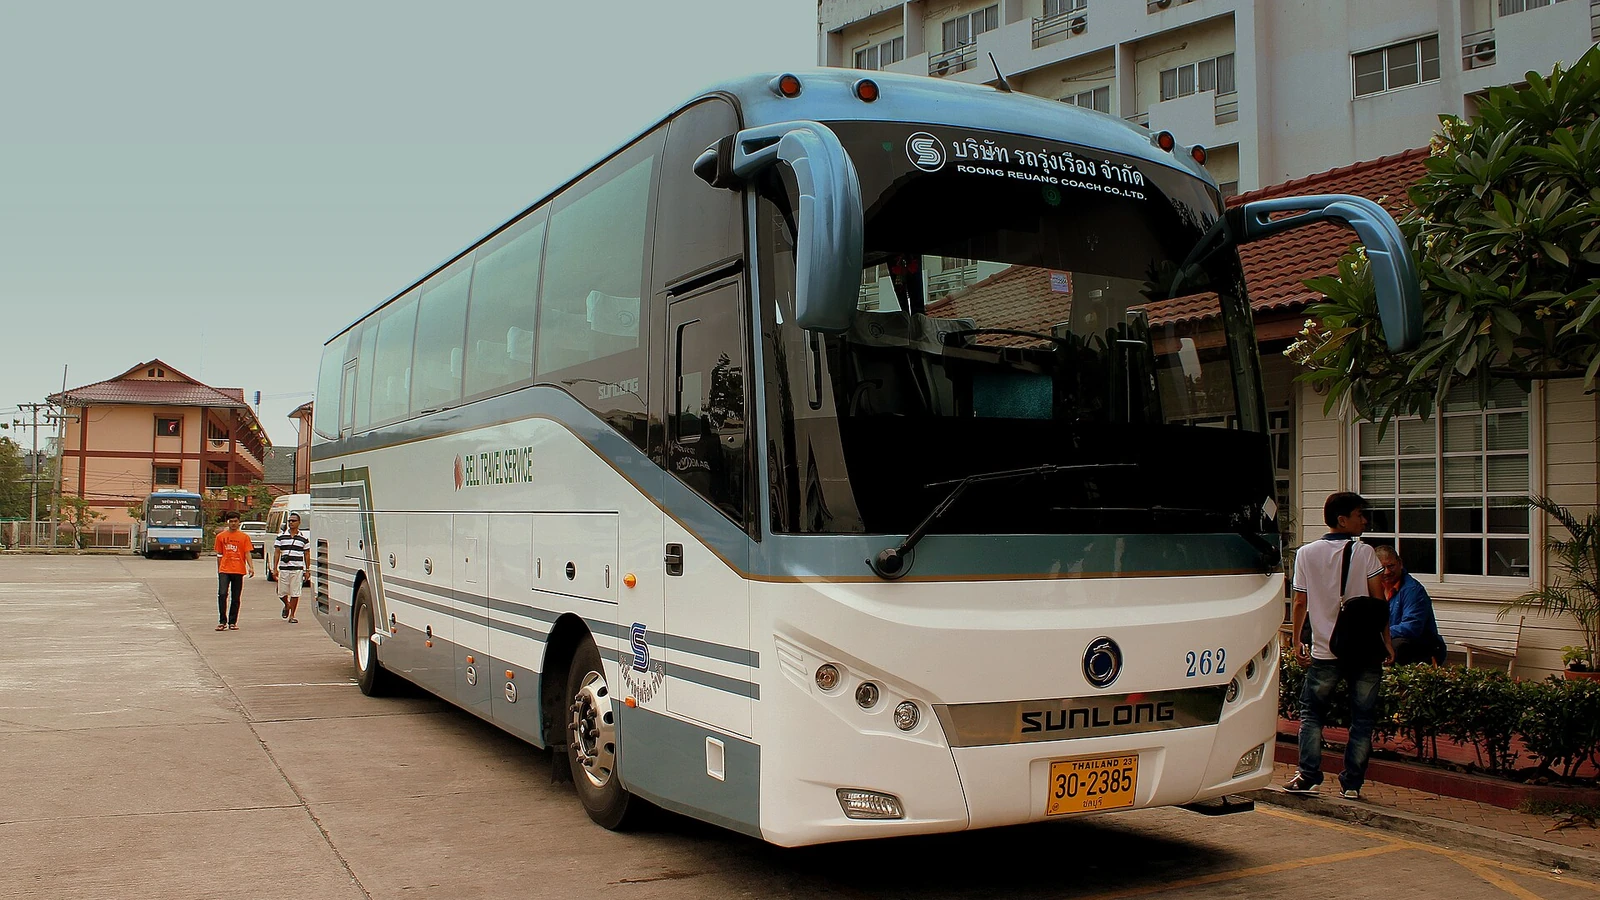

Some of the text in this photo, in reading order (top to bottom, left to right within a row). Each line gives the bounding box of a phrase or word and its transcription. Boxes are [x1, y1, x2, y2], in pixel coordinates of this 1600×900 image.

[953, 138, 1145, 187] บริษัท รถรุ่งเรือง จำกัด
[957, 165, 1147, 200] ROONG REUANG COACH CO.,LTD.
[598, 377, 639, 400] SUNLONG
[466, 446, 533, 486] BELL TRAVEL SERVICE
[1185, 648, 1226, 678] 262
[1021, 701, 1174, 733] SUNLONG
[1072, 759, 1119, 770] THAILAND
[1055, 768, 1133, 799] 30-2385
[1083, 796, 1103, 808] ชลบุรี
